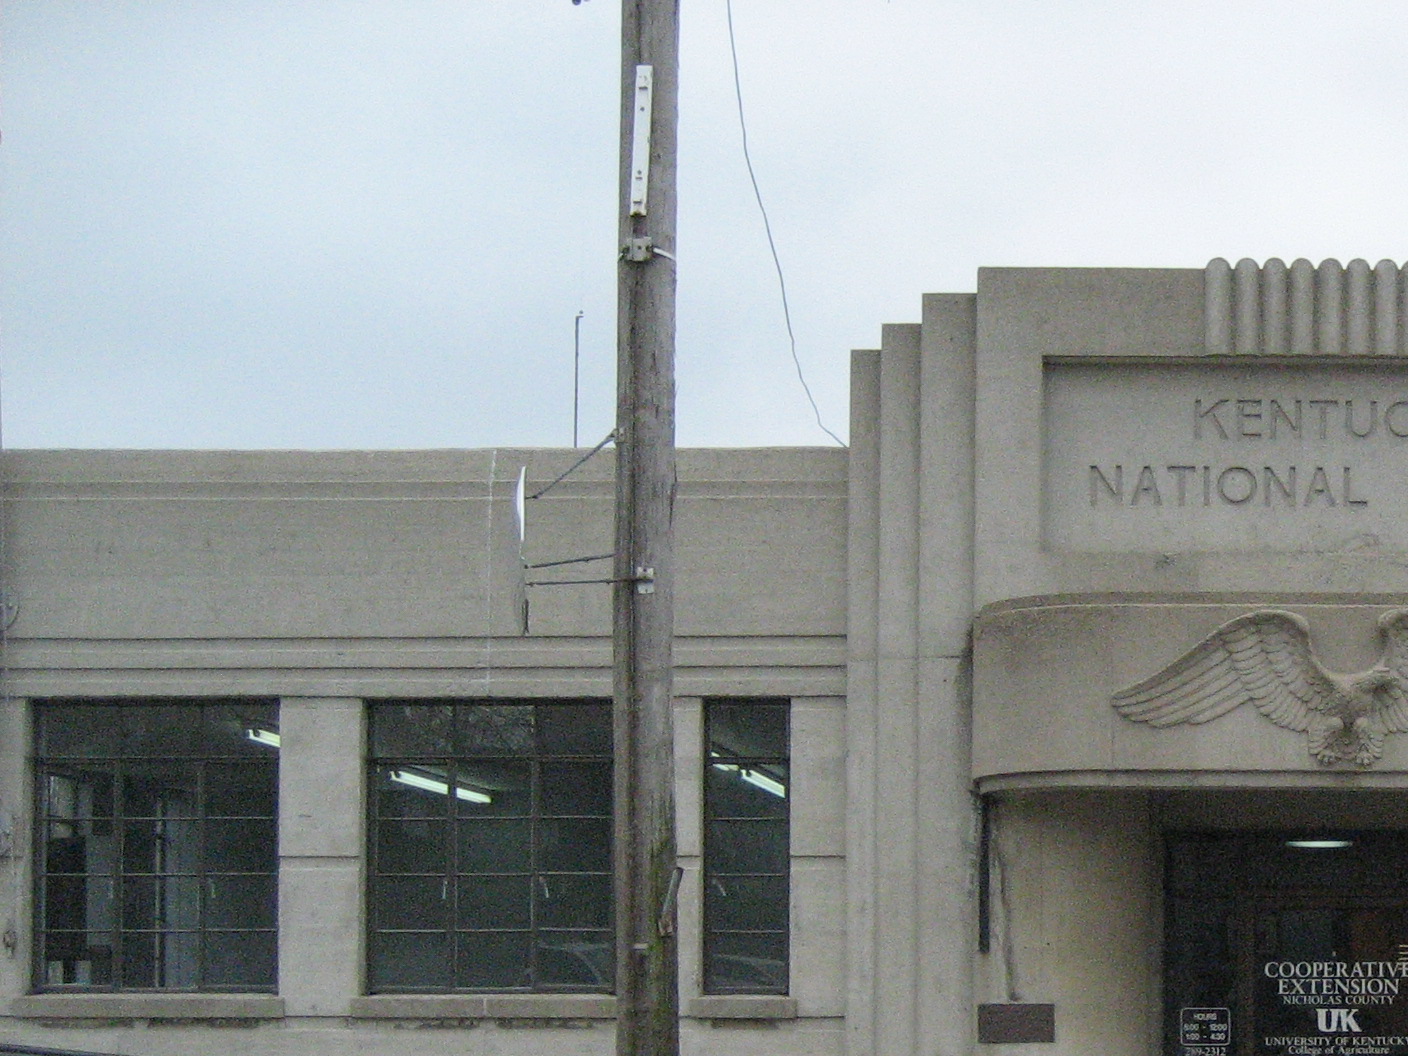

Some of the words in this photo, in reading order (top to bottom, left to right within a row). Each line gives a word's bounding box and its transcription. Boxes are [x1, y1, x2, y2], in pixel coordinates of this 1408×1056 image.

[1087, 464, 1369, 508] NATIONAL
[1277, 978, 1400, 995] EXTENSION
[1283, 995, 1342, 1005] NICHOLAS
[1345, 995, 1395, 1005] COUNTY
[1192, 1012, 1218, 1021] HOURS
[1315, 1008, 1363, 1033] UK
[1265, 1036, 1333, 1046] UNIVERSITY
[1335, 1036, 1350, 1046] OF
[1288, 1045, 1323, 1056] College
[1324, 1045, 1336, 1055] of
[1338, 1045, 1390, 1056] Agriculture
